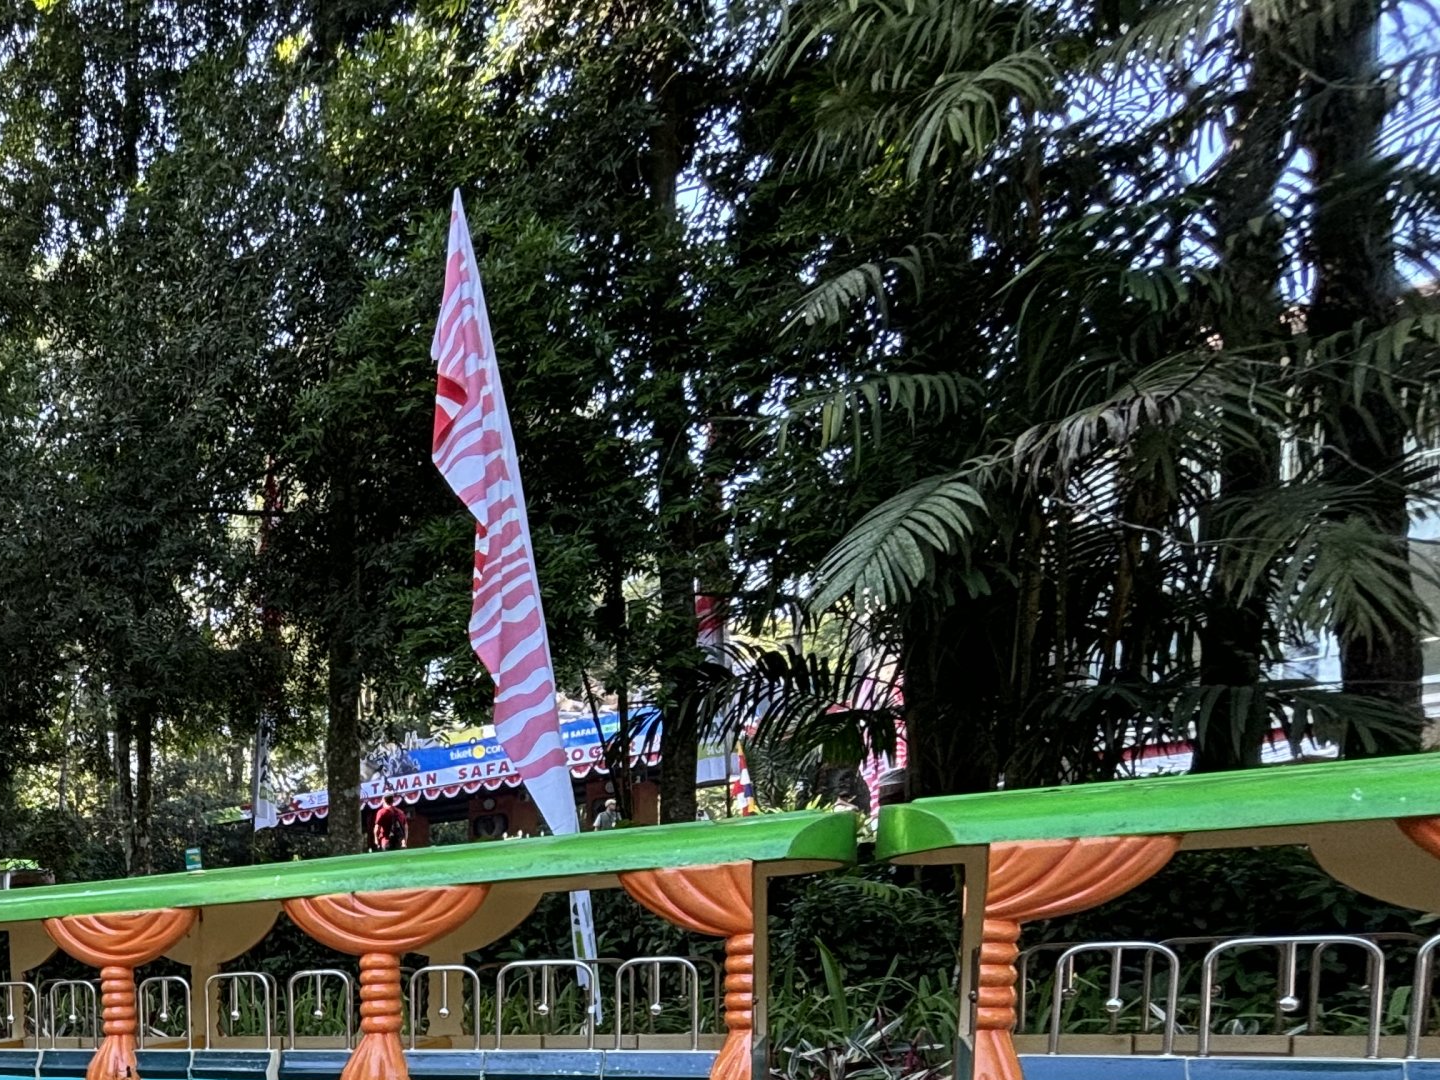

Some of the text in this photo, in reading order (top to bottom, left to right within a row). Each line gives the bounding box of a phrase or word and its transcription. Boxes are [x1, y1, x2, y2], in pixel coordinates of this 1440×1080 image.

[570, 727, 597, 739] SAFAR
[371, 773, 437, 794] TAMAN
[458, 761, 517, 780] SAFA
